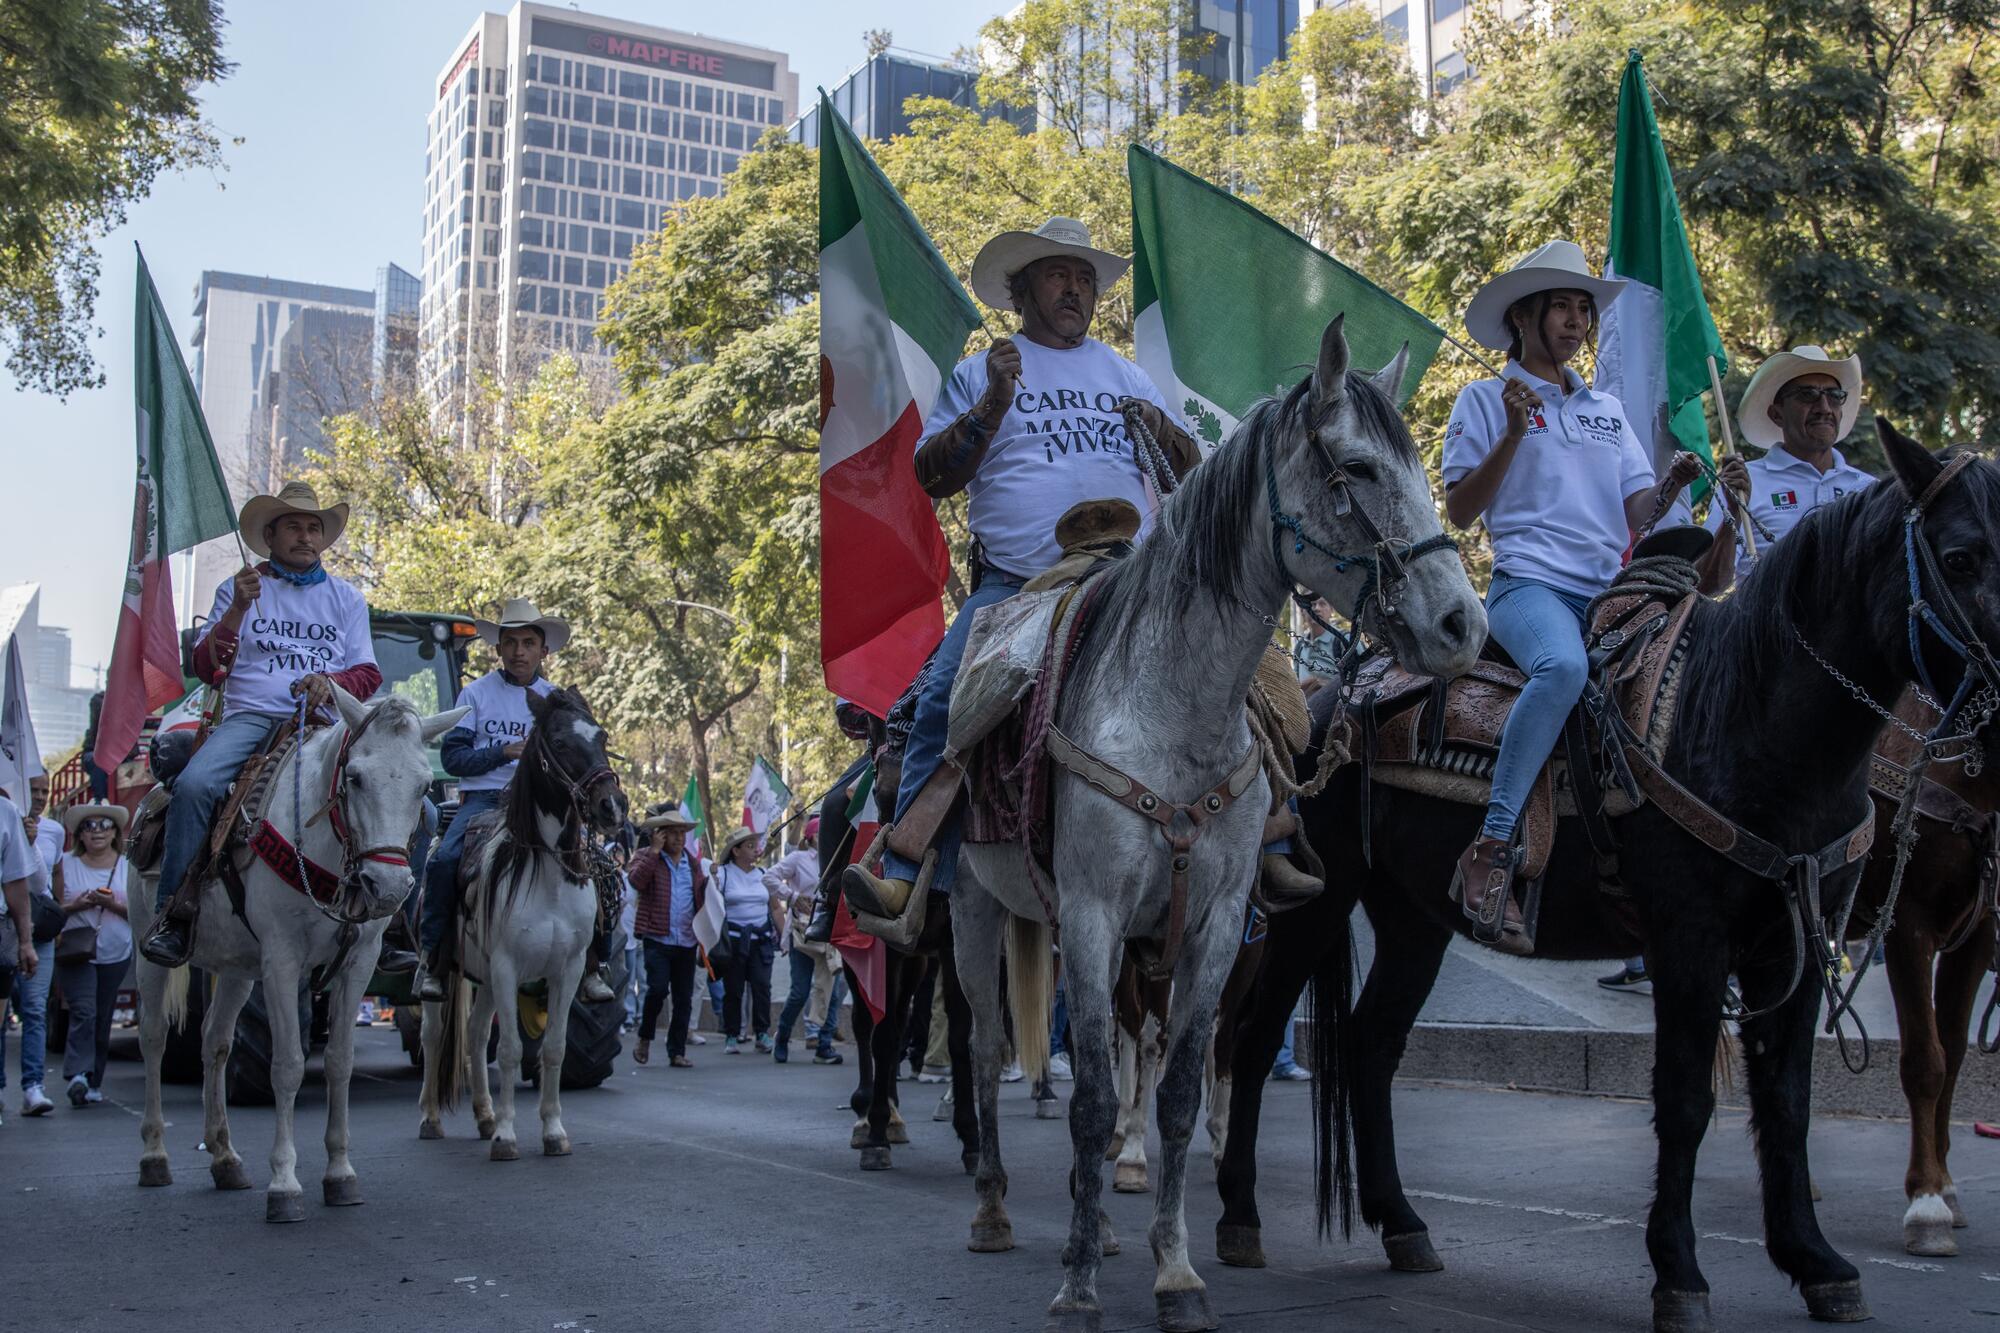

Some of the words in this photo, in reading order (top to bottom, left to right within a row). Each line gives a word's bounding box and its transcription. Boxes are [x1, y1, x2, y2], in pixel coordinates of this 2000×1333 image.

[607, 36, 725, 75] MAPFRE
[1015, 389, 1133, 413] CARLO
[251, 618, 337, 642] CARLOS
[484, 719, 529, 740] CARL
